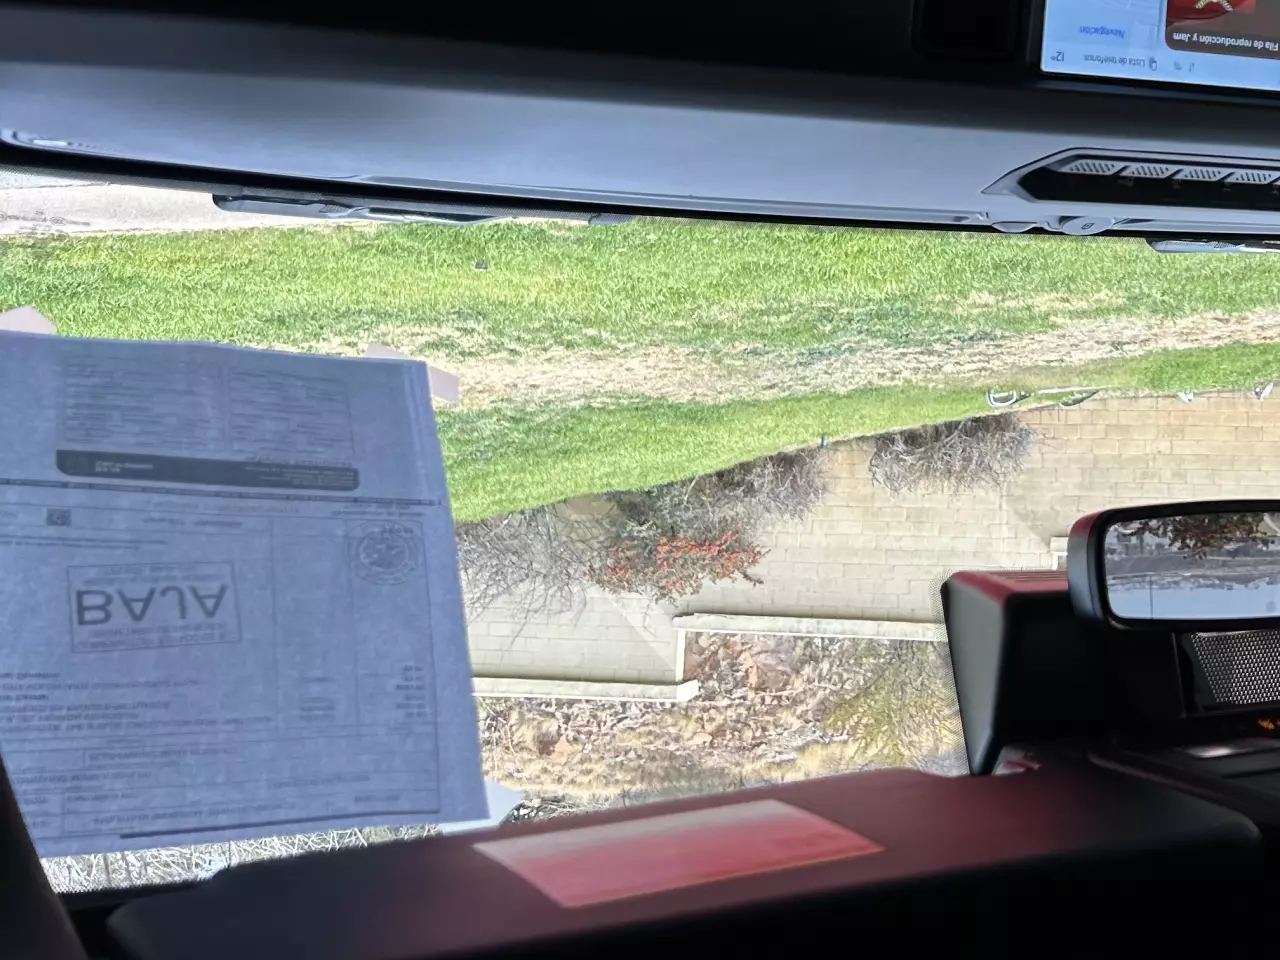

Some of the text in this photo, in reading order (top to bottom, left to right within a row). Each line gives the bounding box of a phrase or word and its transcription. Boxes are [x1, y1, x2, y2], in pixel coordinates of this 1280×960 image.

[1078, 26, 1125, 39] Navegación
[1172, 32, 1191, 42] Jam
[1200, 35, 1252, 47] reproducción
[1253, 40, 1264, 49] de
[1264, 42, 1279, 52] Fila
[1118, 56, 1128, 65] de
[1128, 57, 1146, 68] Lista
